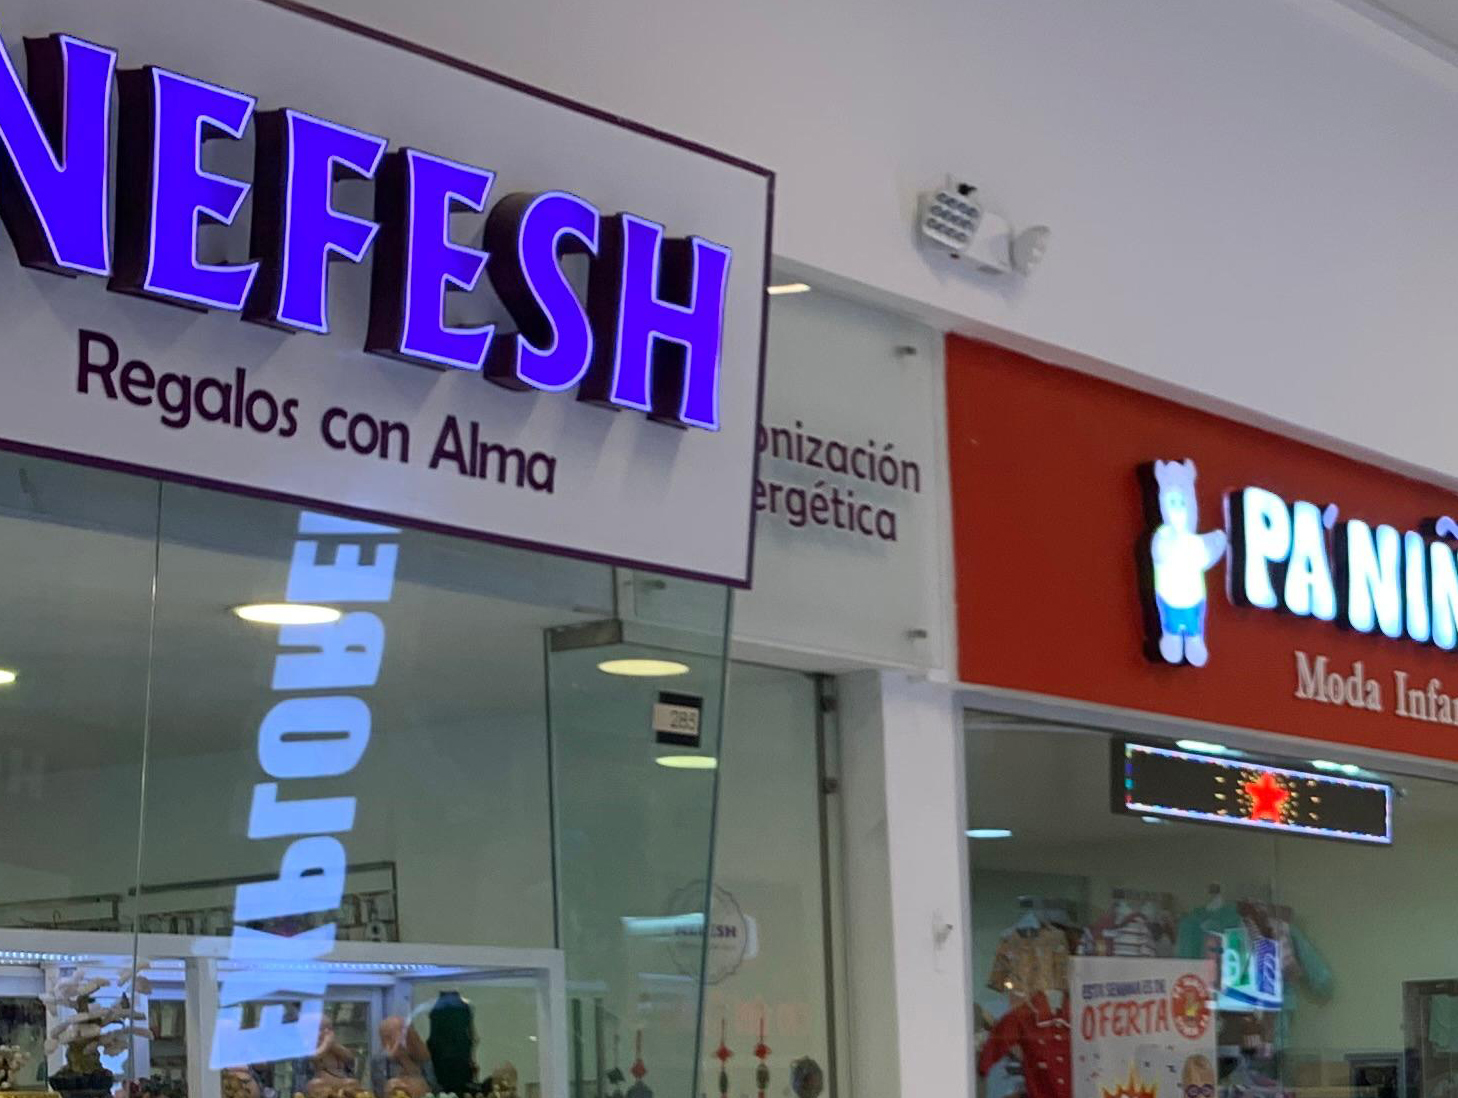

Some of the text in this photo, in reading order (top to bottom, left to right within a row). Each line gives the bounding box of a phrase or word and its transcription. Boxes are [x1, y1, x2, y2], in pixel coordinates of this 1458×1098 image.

[0, 33, 732, 432] NEFESH
[77, 328, 557, 494] Regalos con Alma
[1294, 650, 1383, 712] Moda
[1081, 999, 1170, 1041] OFERTA
